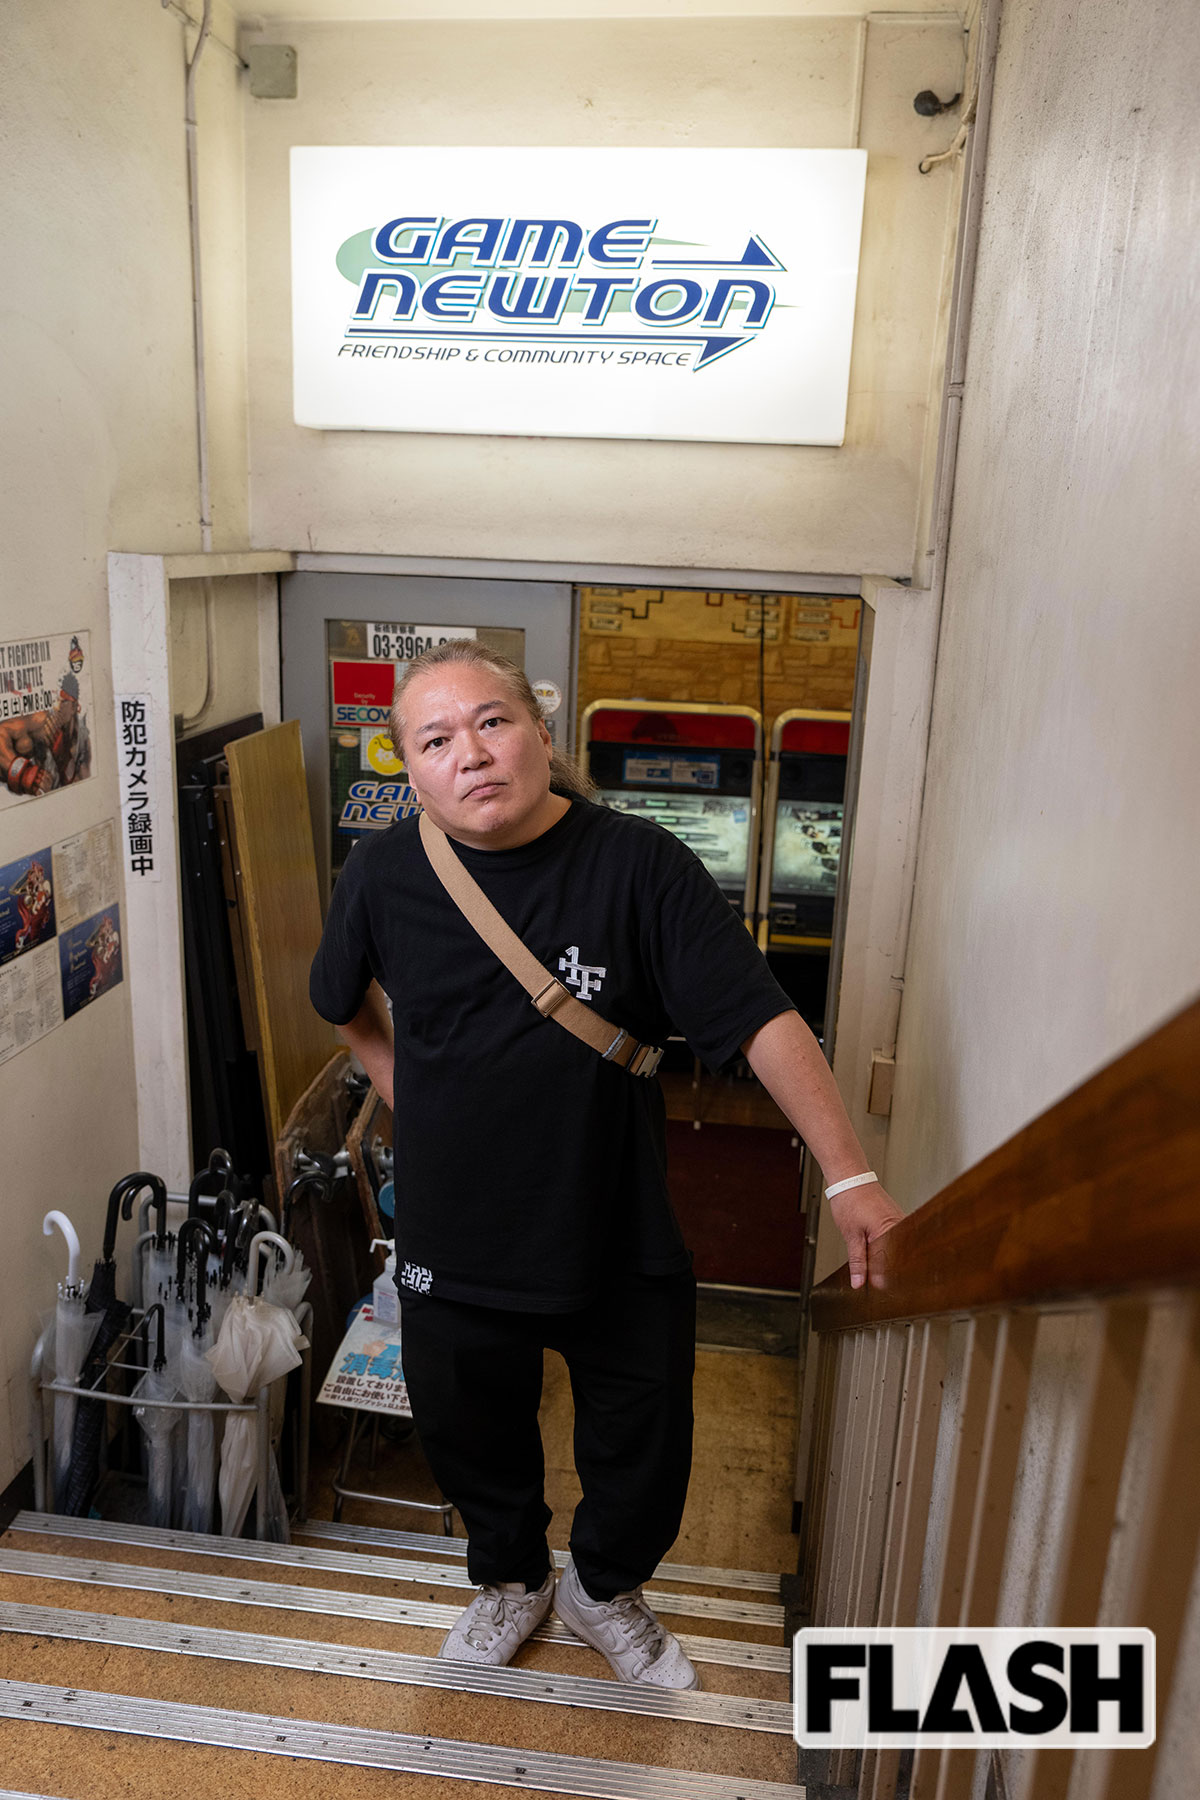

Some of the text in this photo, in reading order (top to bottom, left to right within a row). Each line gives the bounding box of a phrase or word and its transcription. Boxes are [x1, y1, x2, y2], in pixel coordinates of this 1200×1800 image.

[374, 216, 657, 267] GAME
[352, 271, 776, 328] NEWTON
[337, 343, 692, 367] FRIENDSHIP & COMMUNITY SPACE
[17, 666, 43, 690] BATTLE
[121, 701, 154, 876] 防犯カメラ録画中
